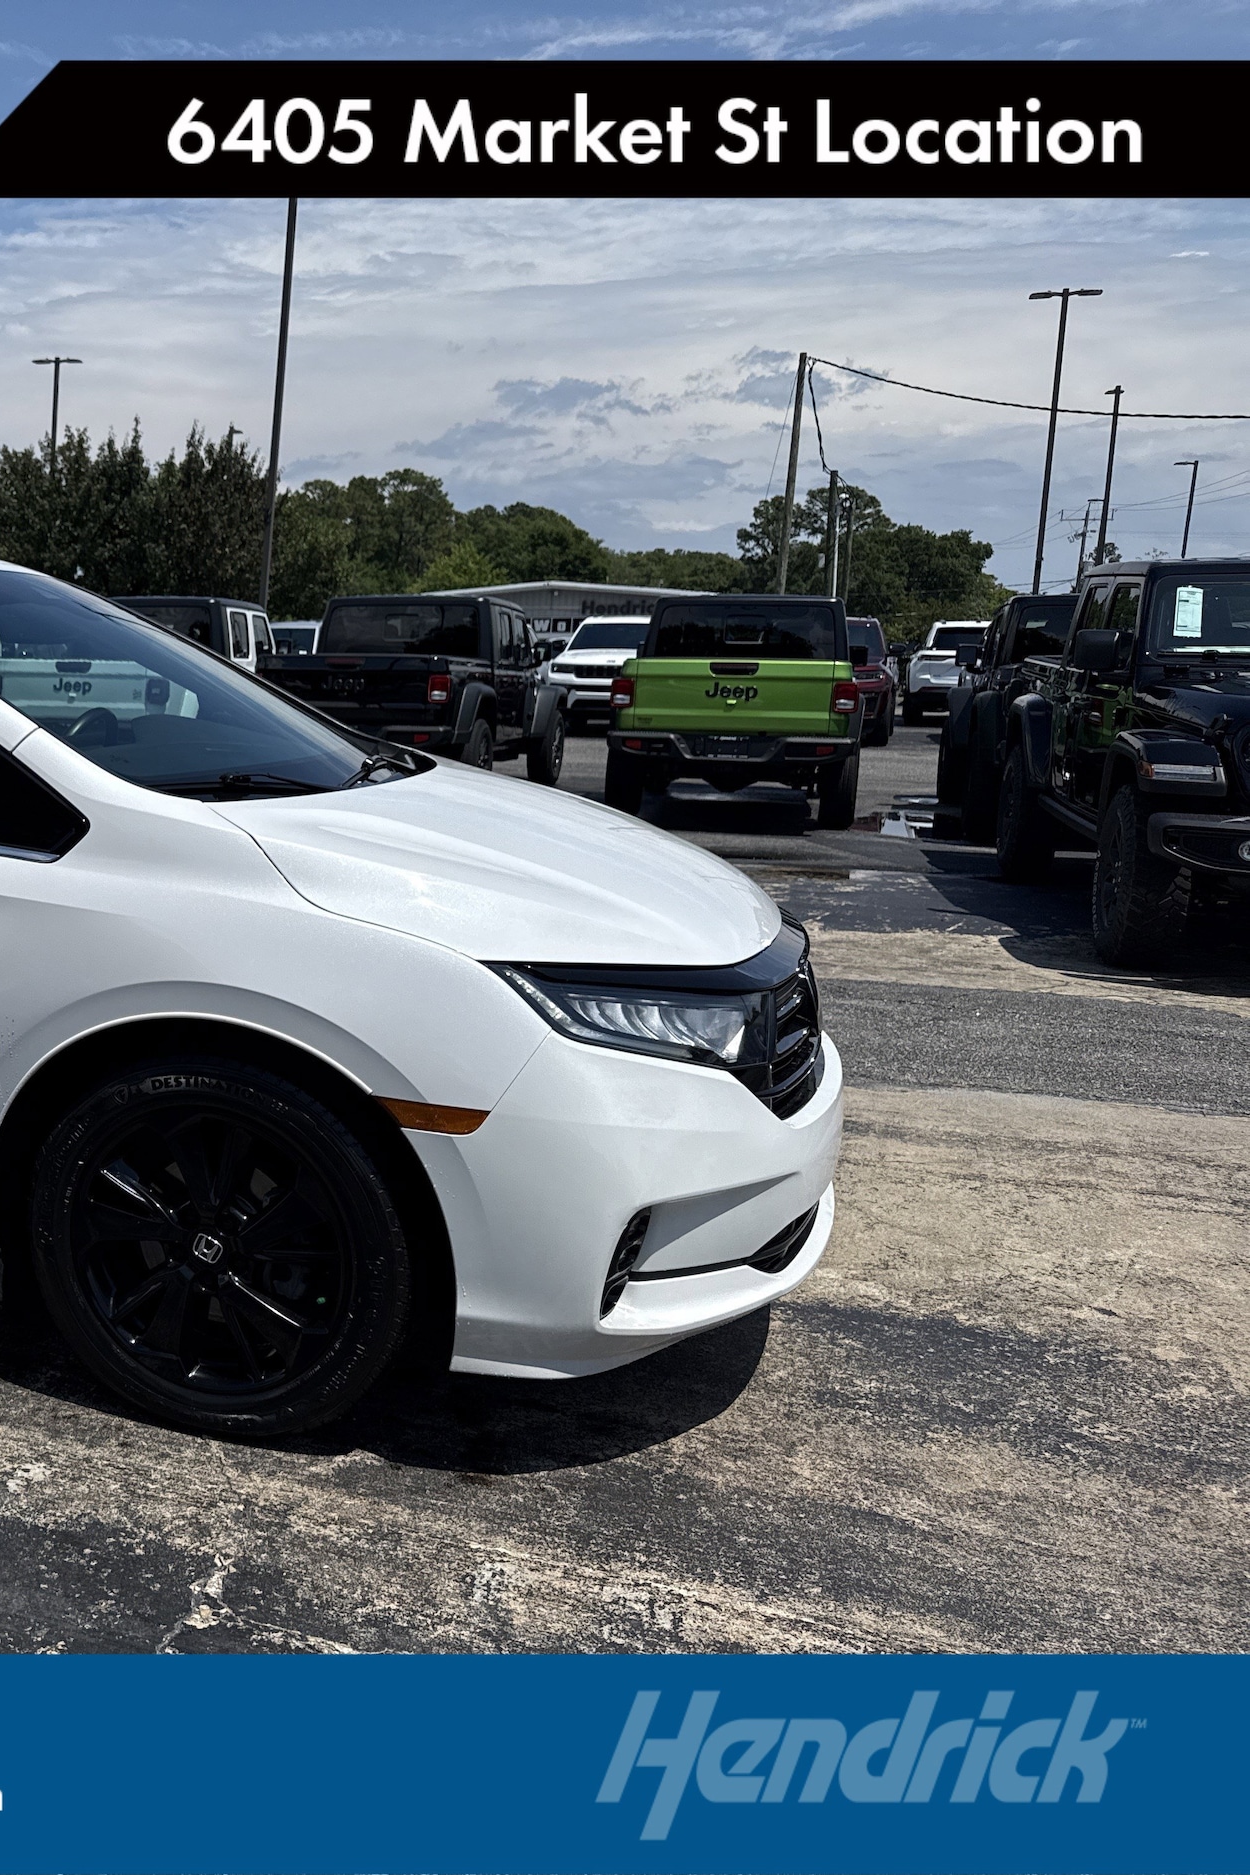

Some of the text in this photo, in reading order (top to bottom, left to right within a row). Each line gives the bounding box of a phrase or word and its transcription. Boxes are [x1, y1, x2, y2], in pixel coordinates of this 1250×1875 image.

[53, 677, 92, 696] Jeep
[320, 675, 365, 694] Jeep
[705, 681, 758, 702] Jeep
